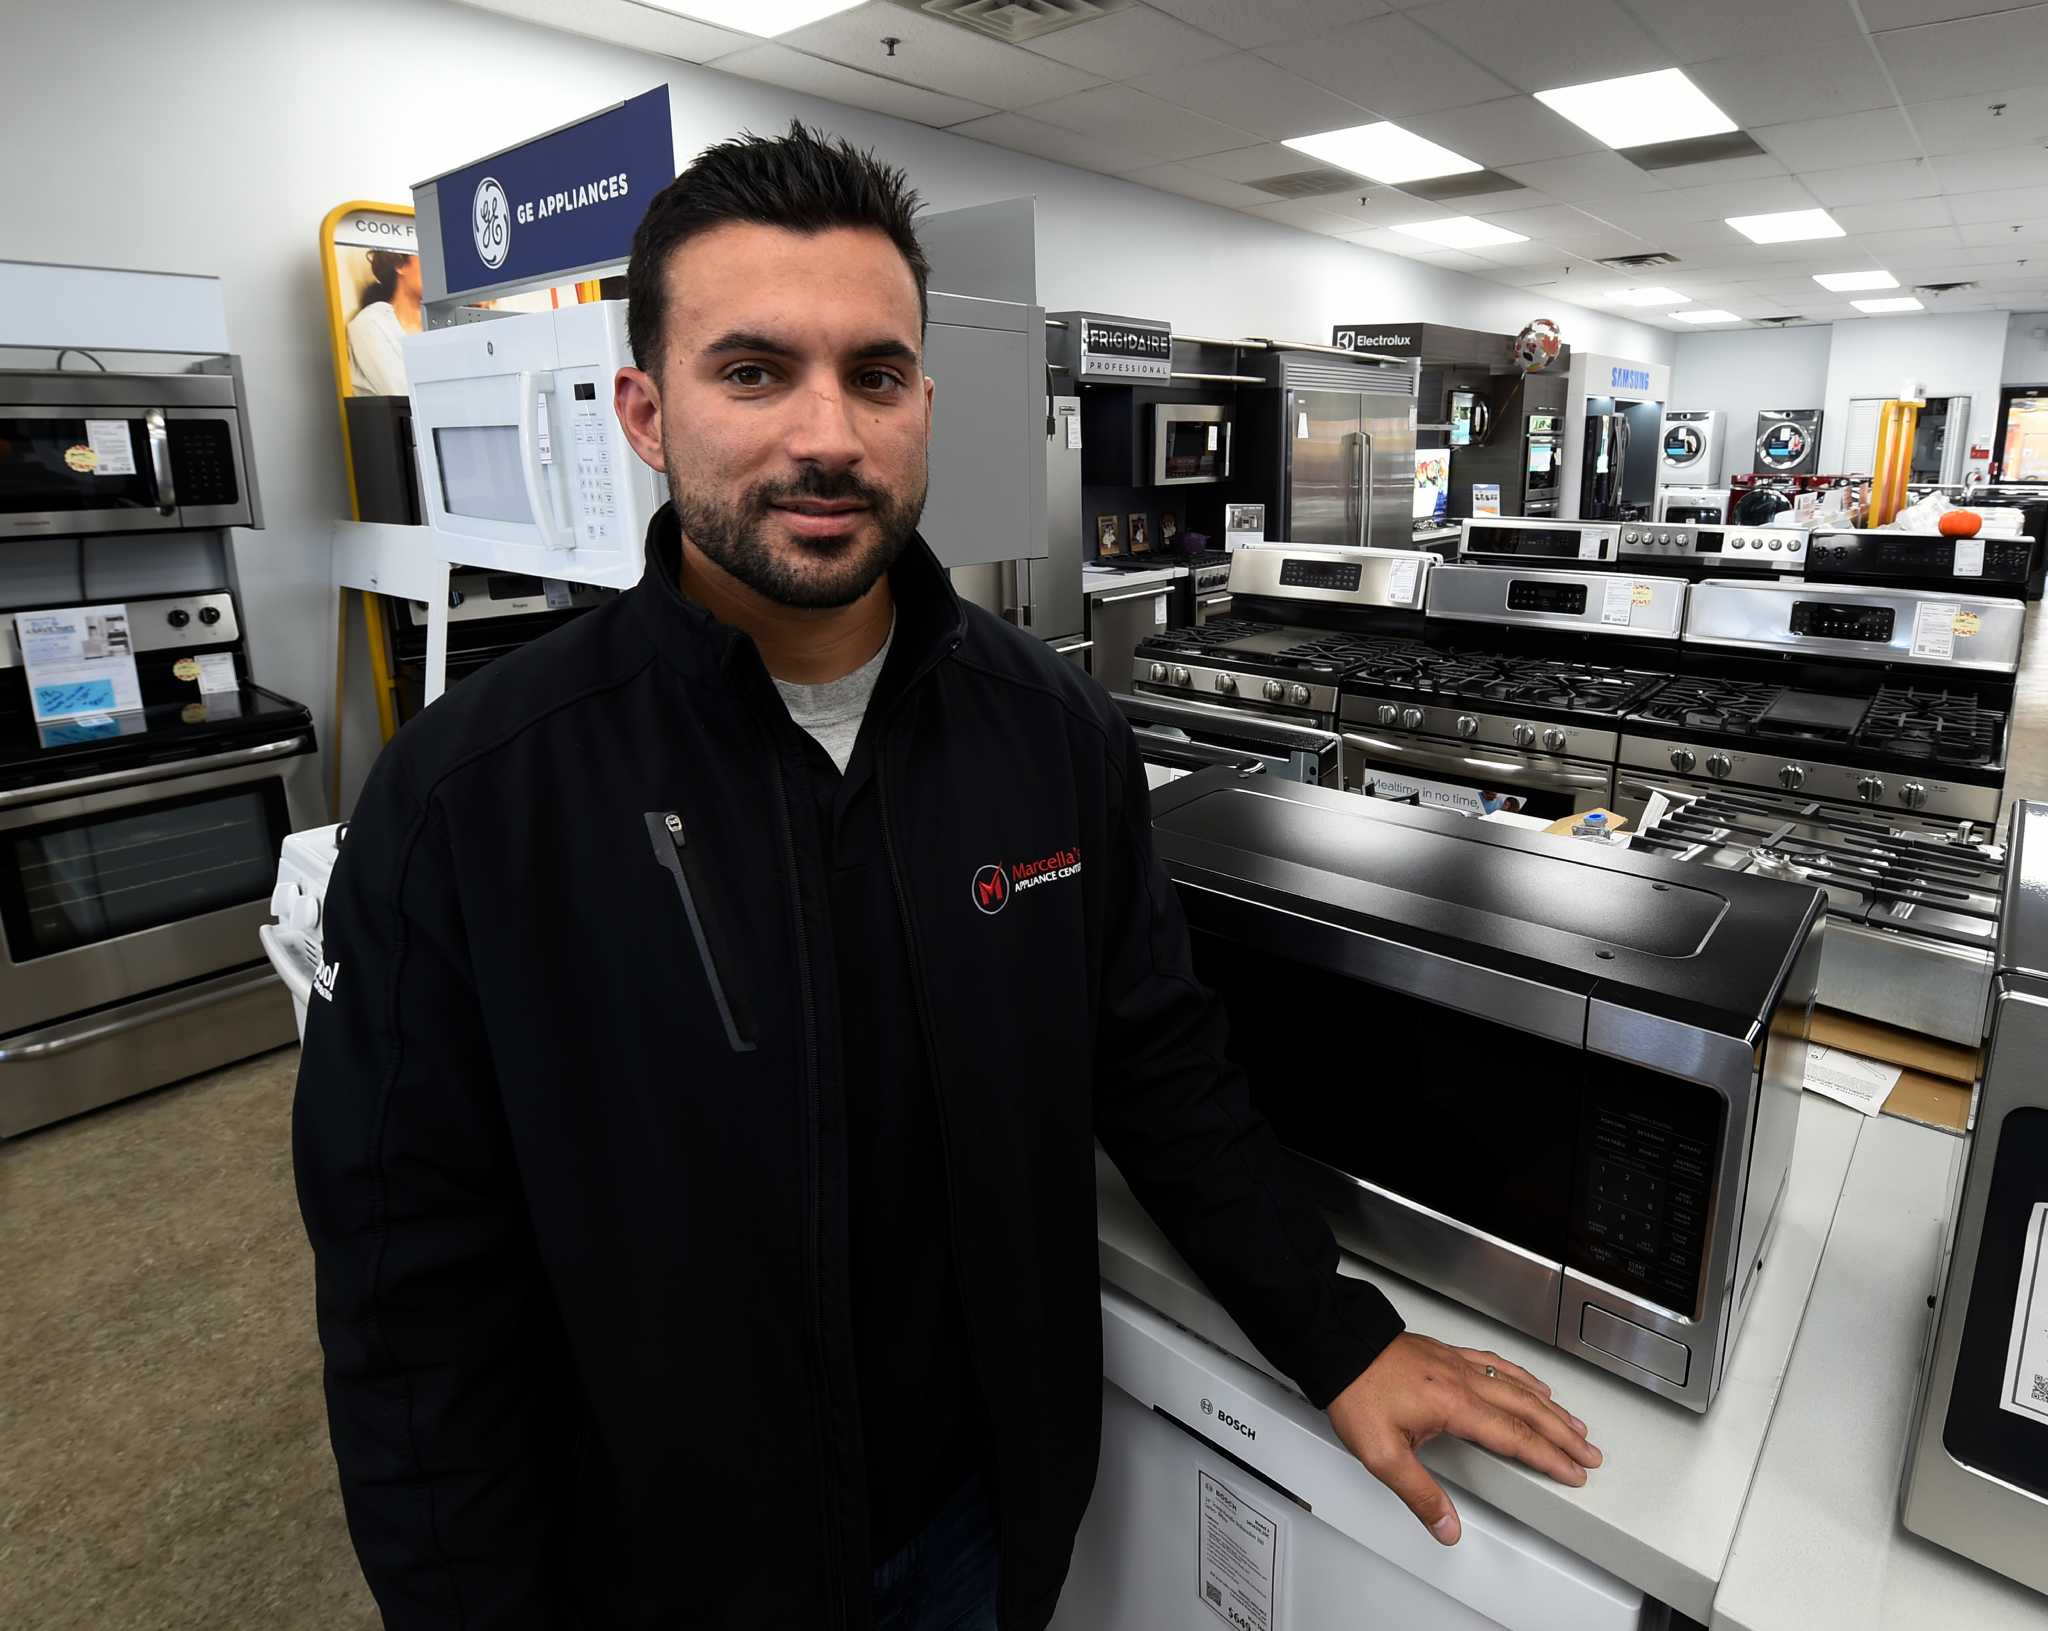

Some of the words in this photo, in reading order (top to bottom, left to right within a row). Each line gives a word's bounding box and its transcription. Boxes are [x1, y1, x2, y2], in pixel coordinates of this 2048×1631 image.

[516, 202, 535, 225] GE
[538, 173, 629, 219] APPLIANCES
[355, 219, 402, 236] COOK
[1090, 329, 1168, 352] FRIGIDAIRE
[1357, 334, 1411, 347] Electrolux
[1089, 361, 1167, 375] PROFESSIONAL
[1611, 367, 1649, 390] SAMSUNG
[1422, 786, 1432, 799] in
[1434, 791, 1450, 802] no
[1452, 793, 1480, 809] time,
[1014, 870, 1058, 892] APPLIANCE
[1218, 1409, 1256, 1440] BOSCH
